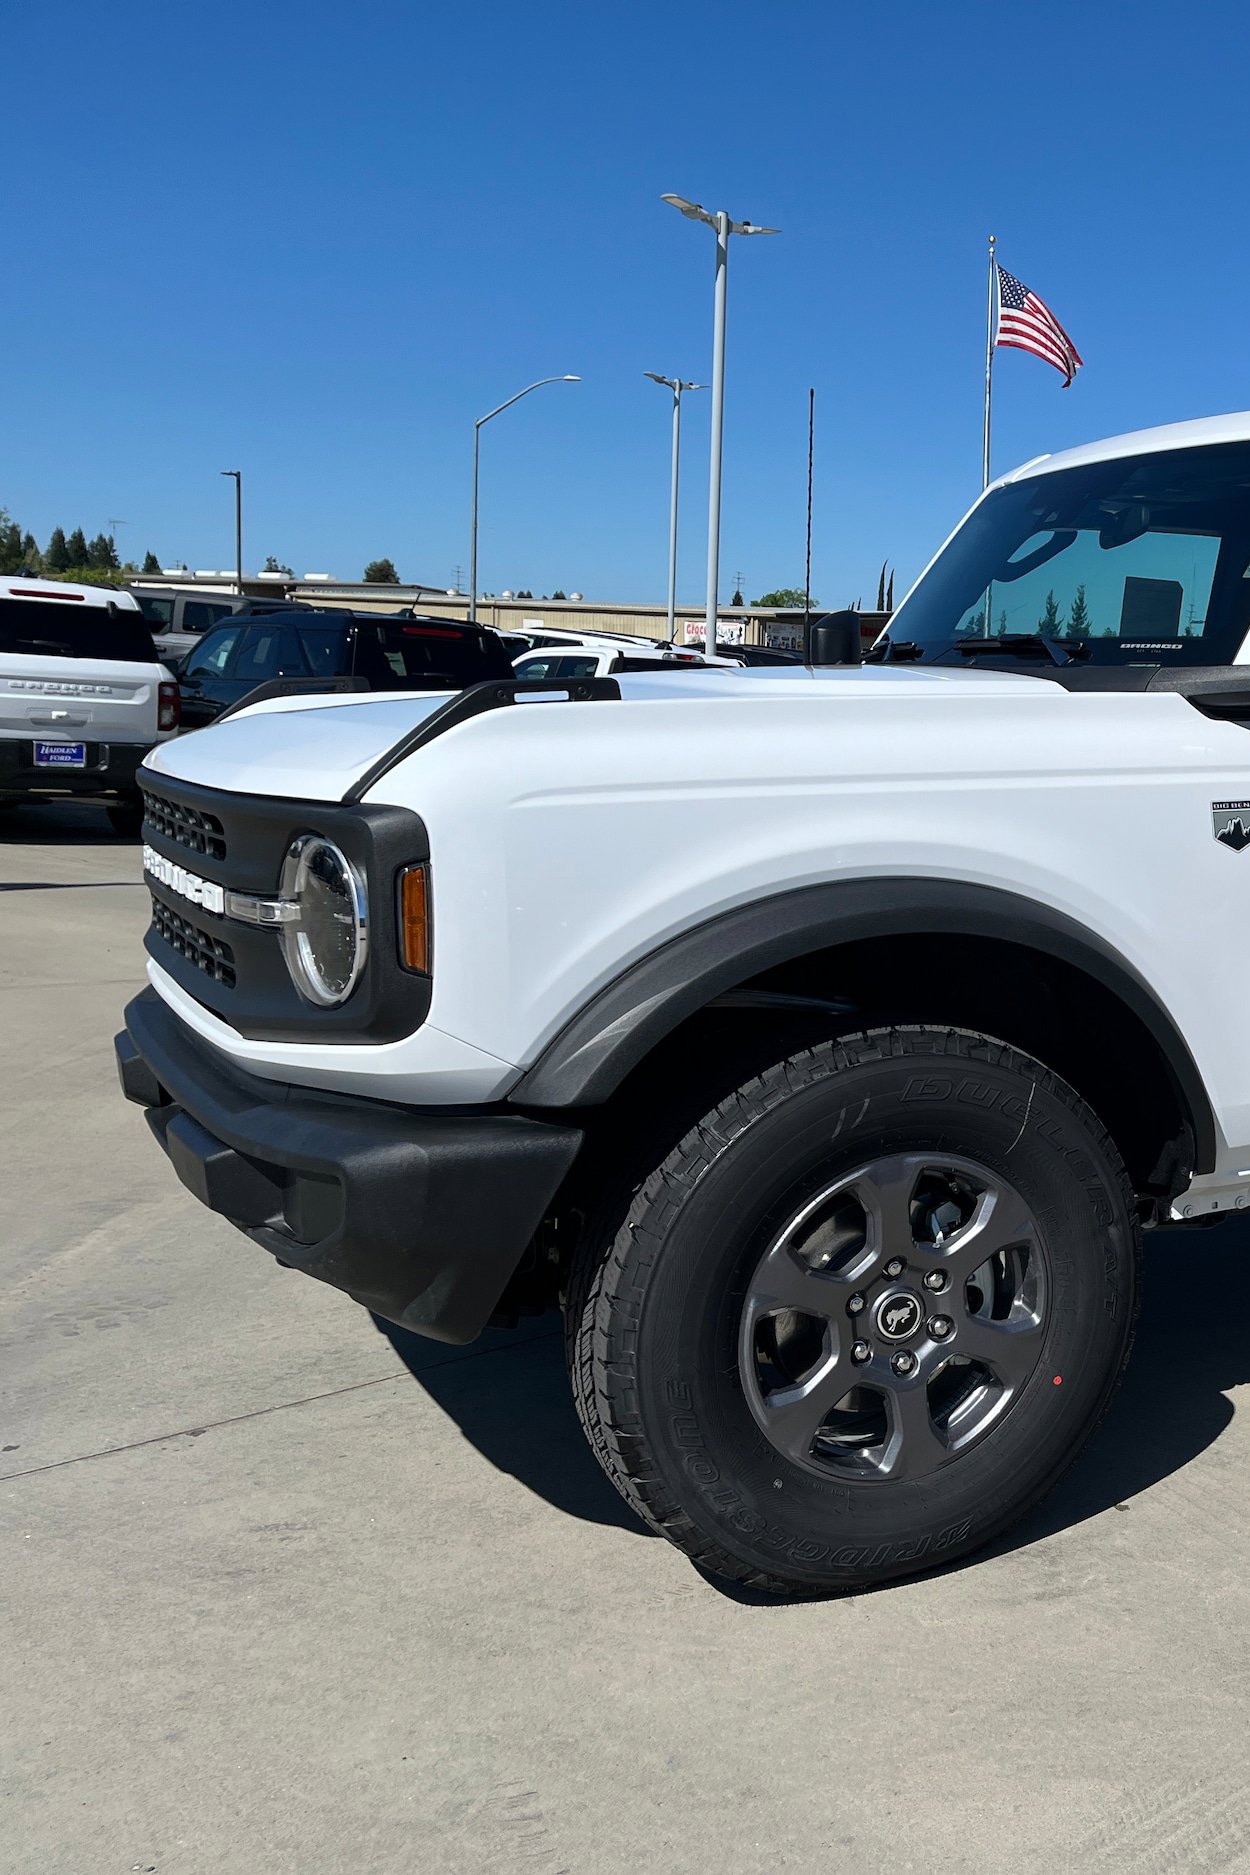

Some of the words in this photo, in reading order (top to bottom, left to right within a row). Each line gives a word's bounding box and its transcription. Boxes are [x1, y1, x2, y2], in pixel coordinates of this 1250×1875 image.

[687, 624, 706, 635] Groc
[8, 680, 112, 693] BRONCO
[143, 844, 224, 914] BRONCO
[900, 1074, 1115, 1229] DUELER
[665, 1378, 976, 1570] BRIDGESTONE
